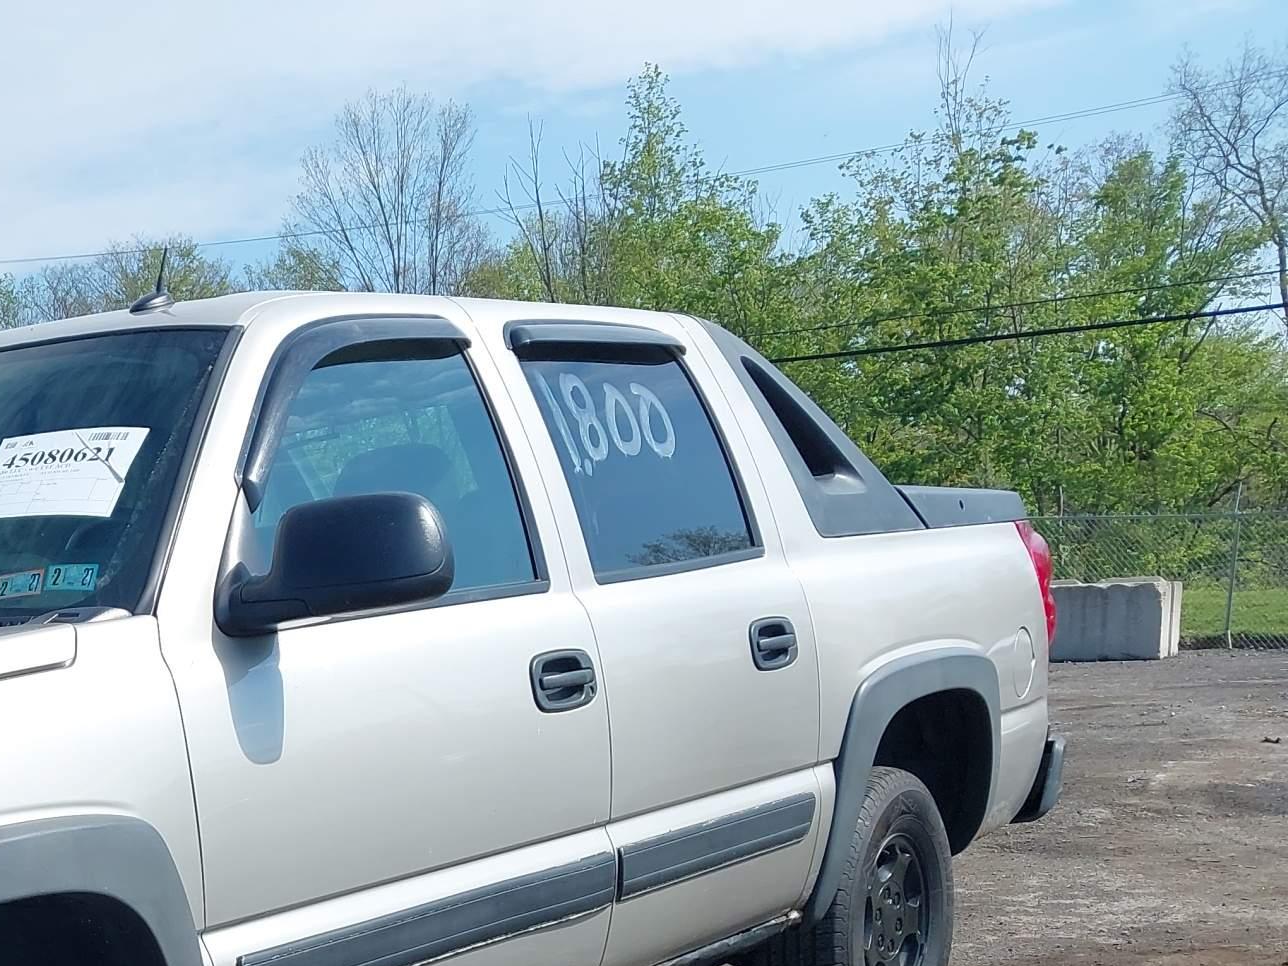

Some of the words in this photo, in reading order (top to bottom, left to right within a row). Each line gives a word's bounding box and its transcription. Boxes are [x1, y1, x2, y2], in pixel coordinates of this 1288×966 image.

[2, 446, 116, 470] 45080621
[0, 581, 9, 597] 2
[27, 572, 42, 593] 27
[51, 567, 62, 586] 2
[80, 567, 94, 587] 27
